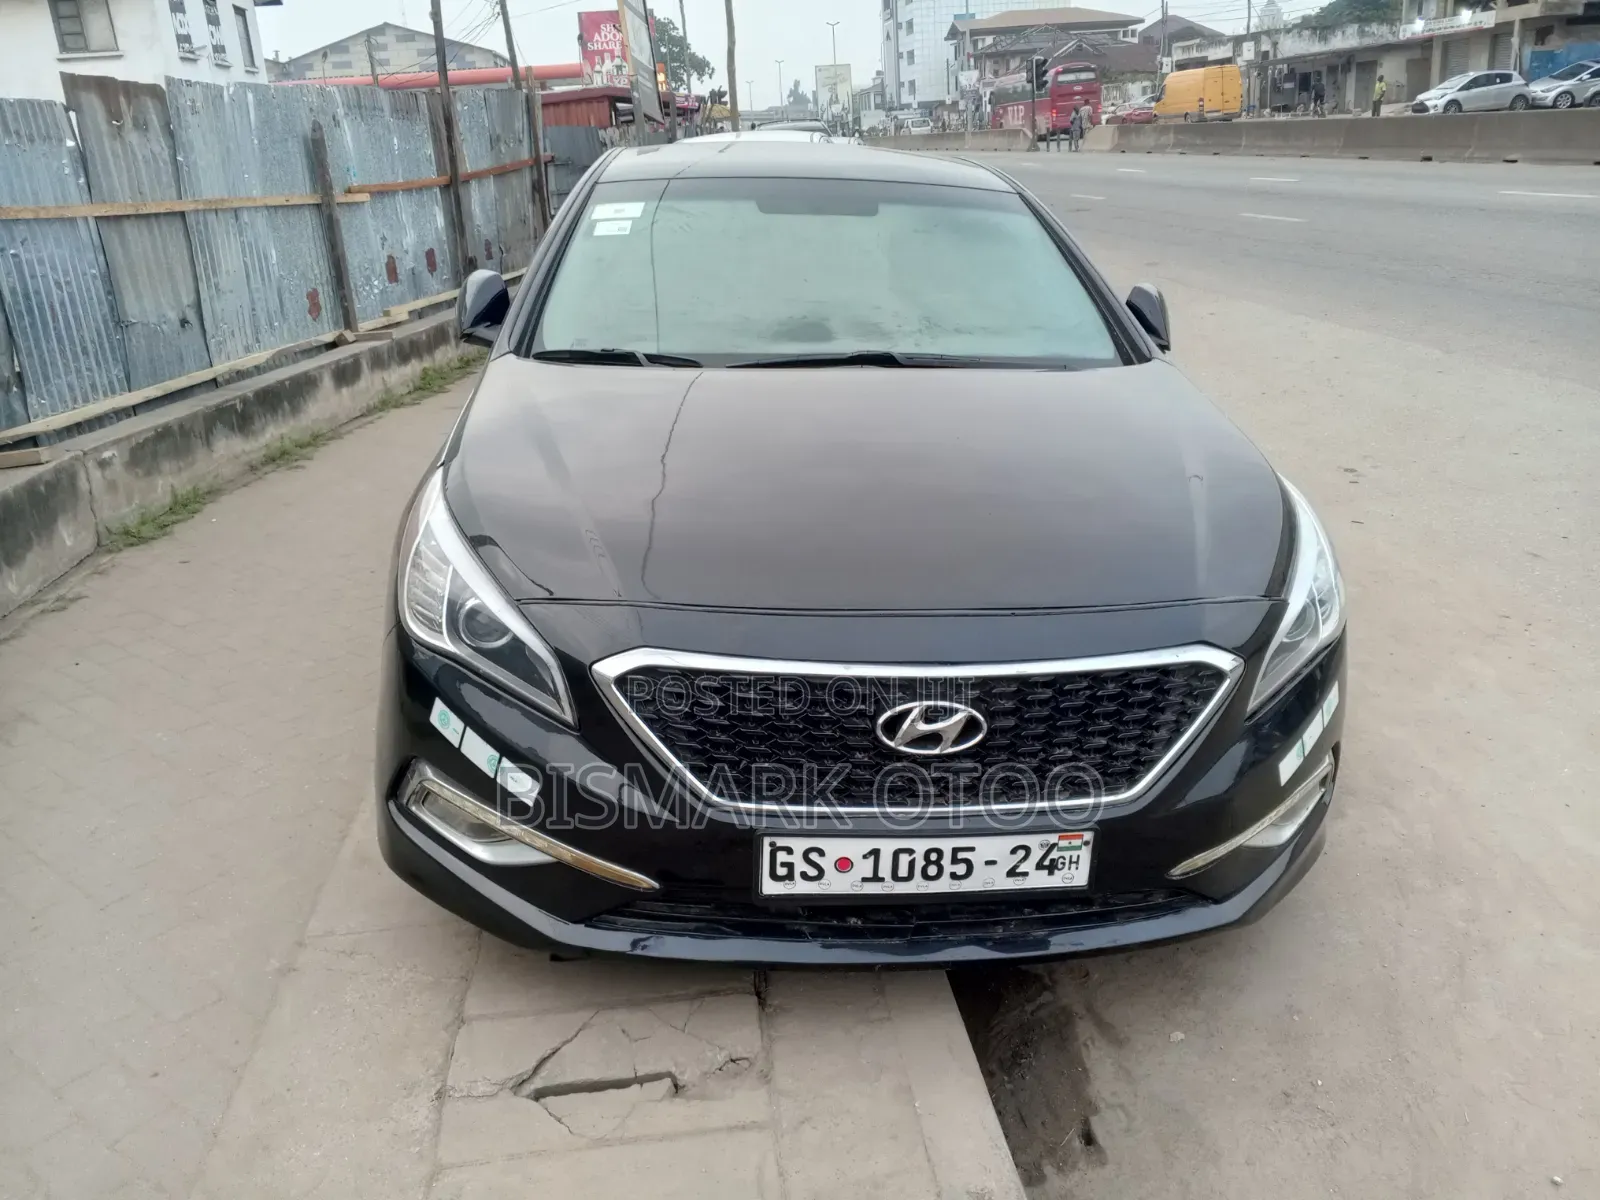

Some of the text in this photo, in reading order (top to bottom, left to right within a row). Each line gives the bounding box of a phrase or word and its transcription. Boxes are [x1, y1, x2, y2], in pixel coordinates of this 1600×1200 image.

[587, 41, 622, 51] SHARE
[769, 846, 826, 882] GS
[1055, 854, 1080, 872] GH
